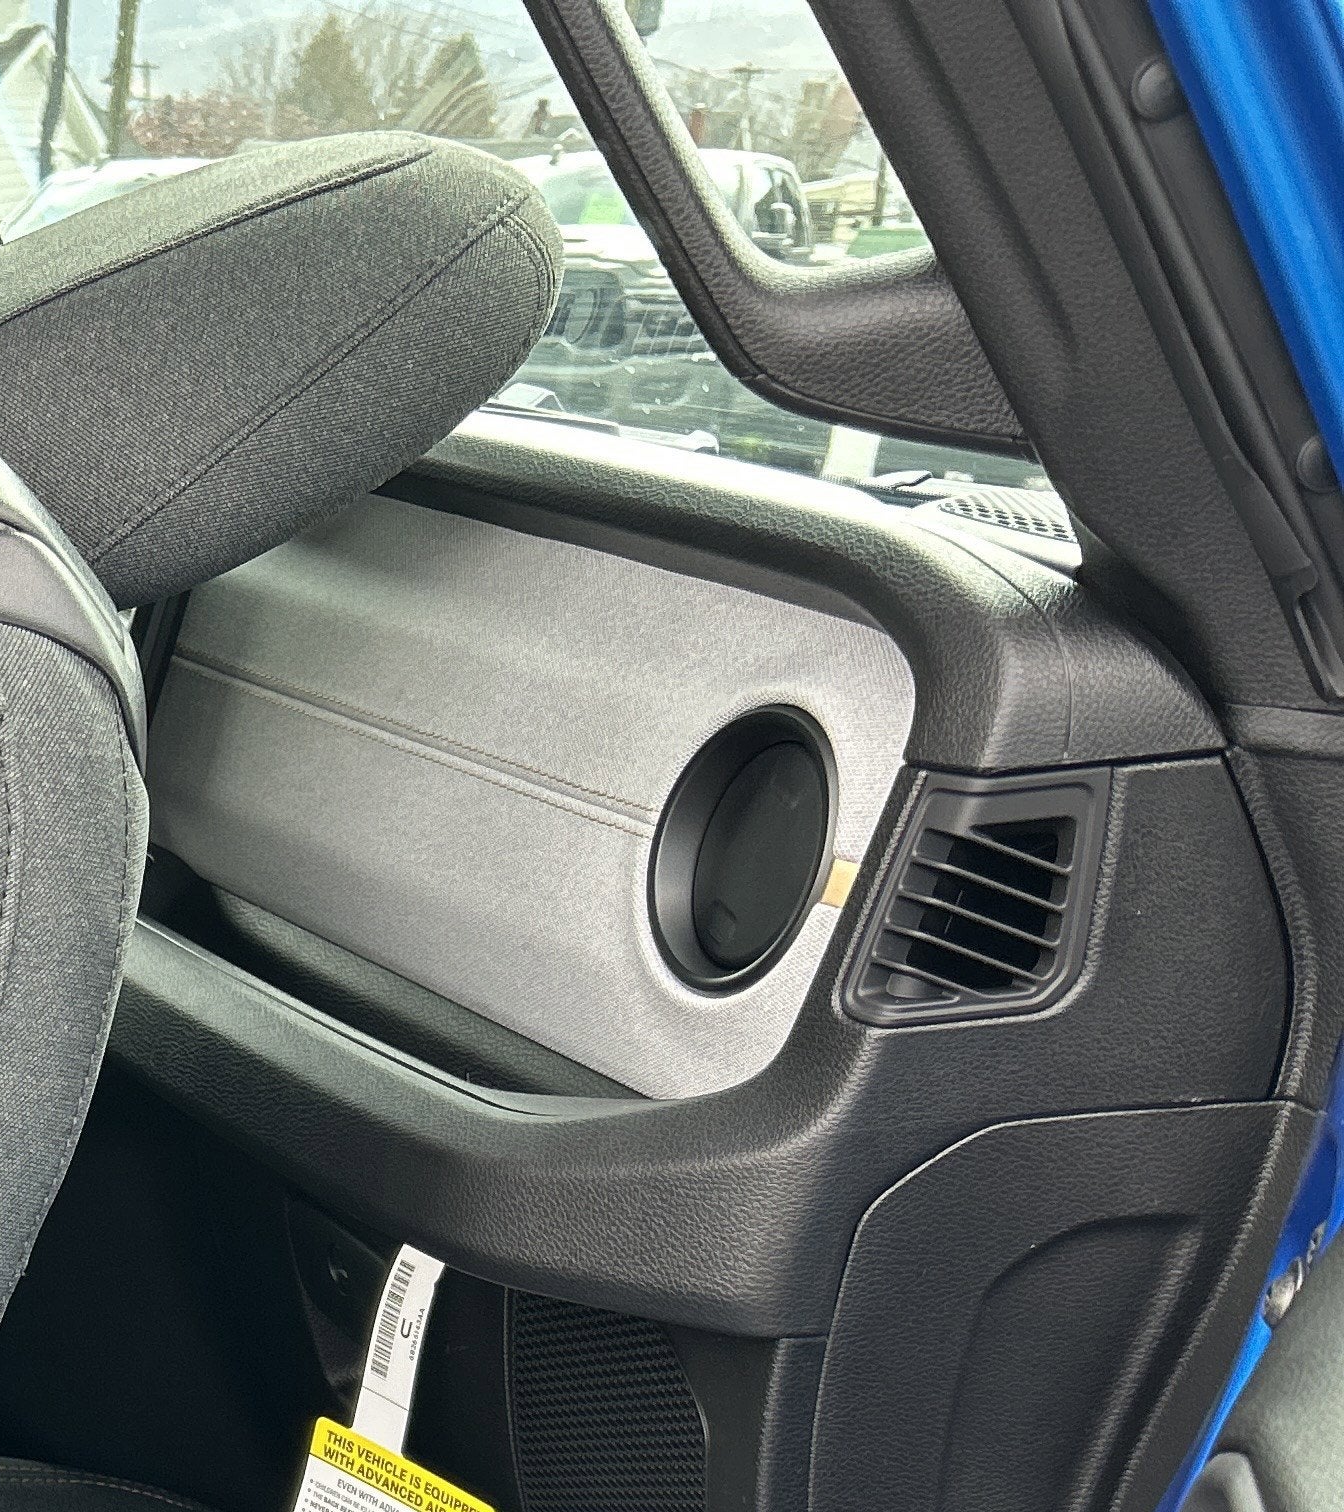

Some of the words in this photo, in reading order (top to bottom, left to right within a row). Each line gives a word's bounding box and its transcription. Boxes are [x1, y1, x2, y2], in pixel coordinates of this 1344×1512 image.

[322, 1443, 354, 1470] WITH
[358, 1463, 422, 1507] ADVANCED
[326, 1429, 354, 1453] THIS
[356, 1445, 407, 1481] VEHICLE
[409, 1473, 421, 1489] IS
[337, 1478, 358, 1496] EVEN
[357, 1489, 378, 1507] WITH
